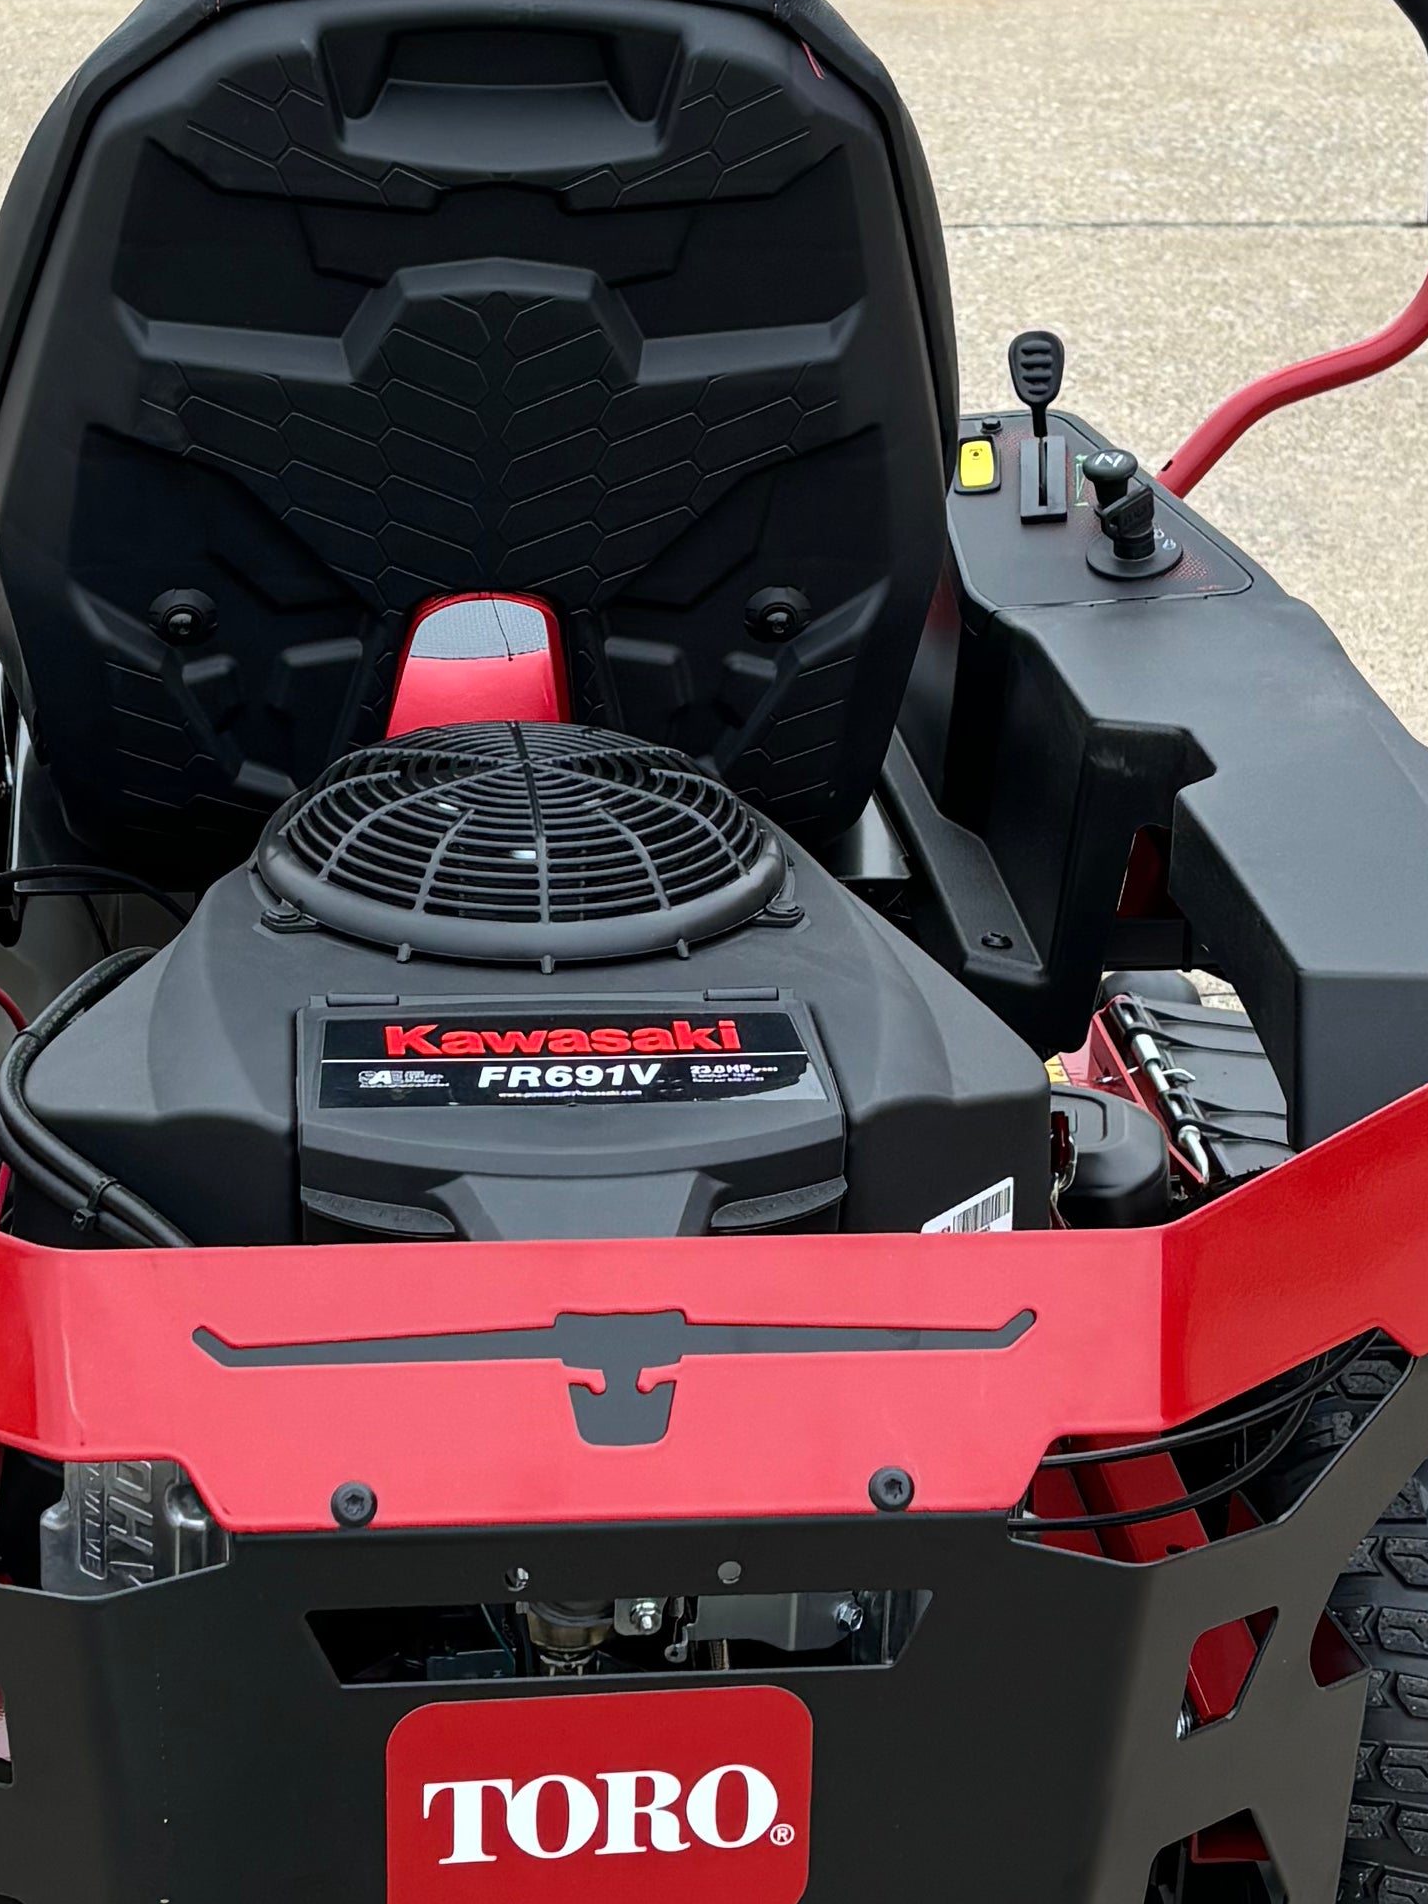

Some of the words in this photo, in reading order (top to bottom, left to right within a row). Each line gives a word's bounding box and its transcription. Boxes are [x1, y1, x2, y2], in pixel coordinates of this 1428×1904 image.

[384, 1019, 741, 1057] Kawasaki
[478, 1063, 662, 1088] FR691V
[726, 1063, 752, 1073] HP
